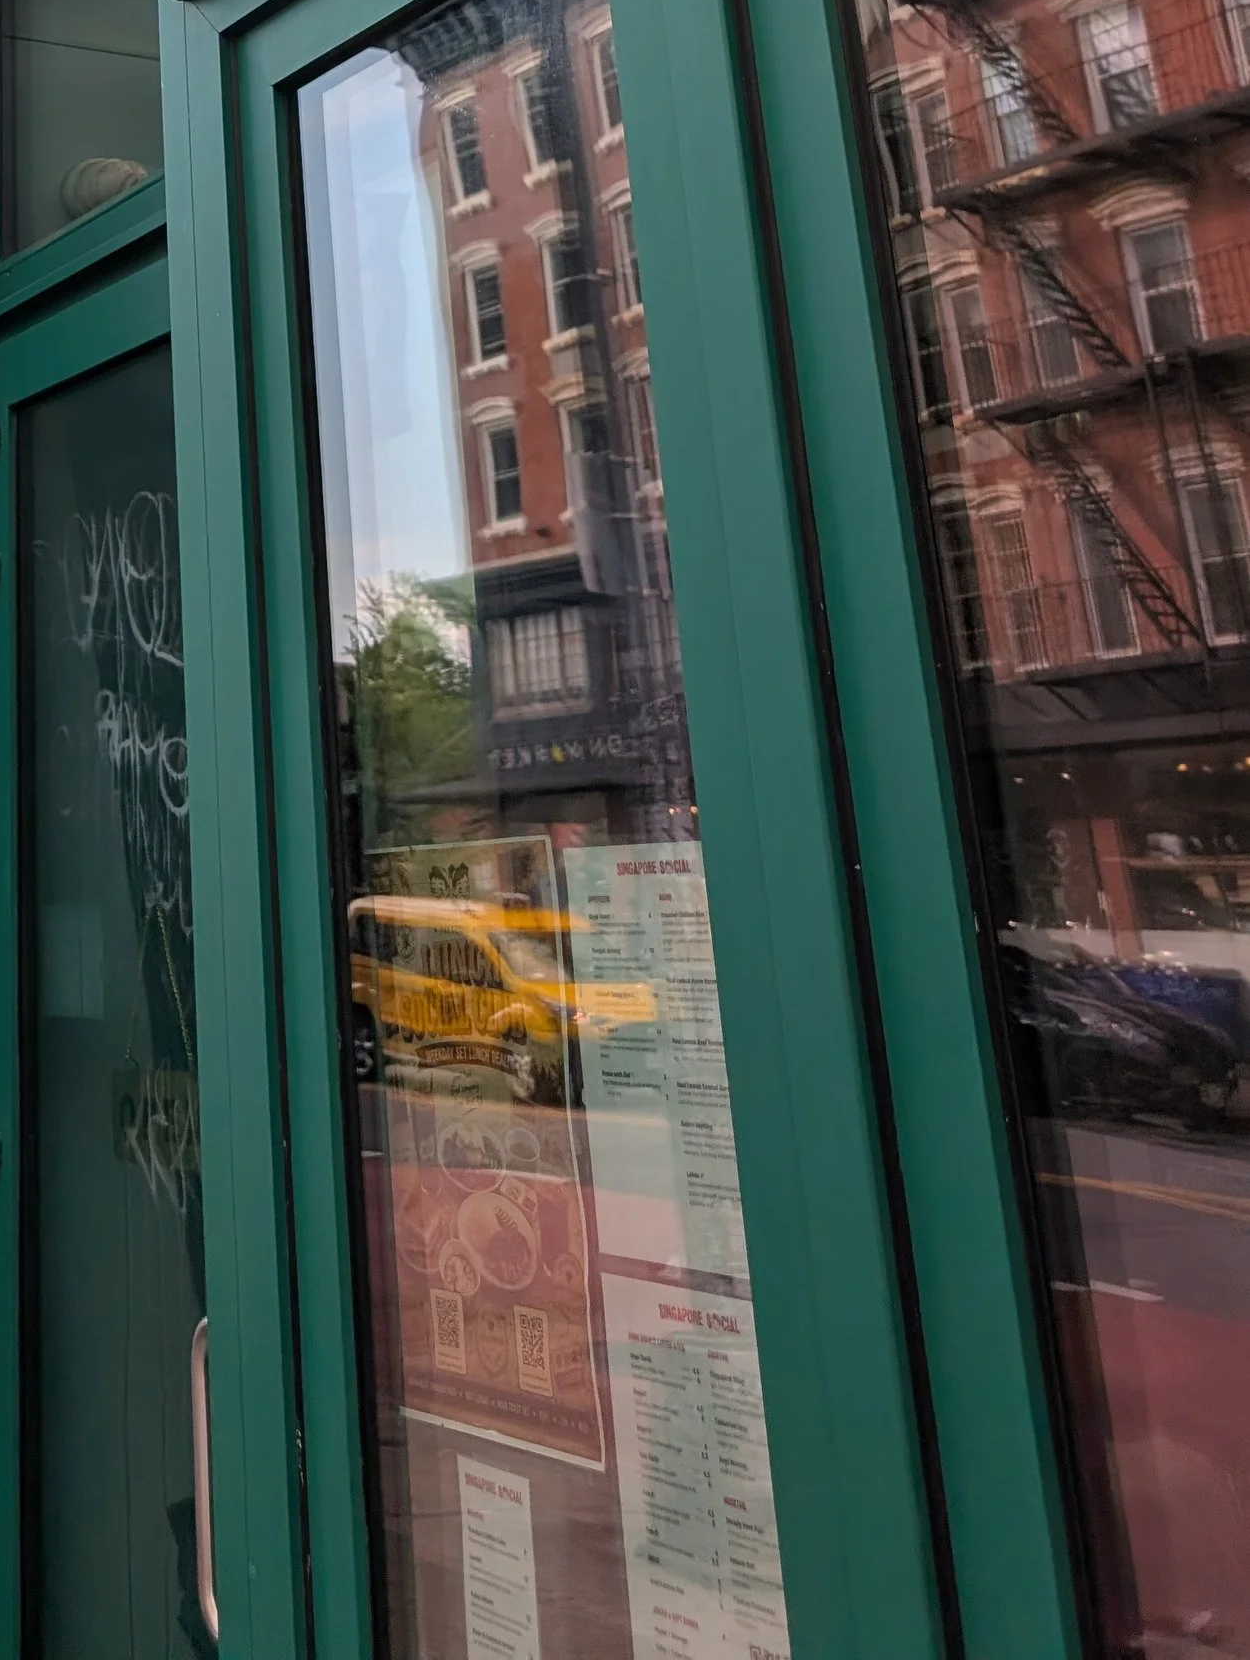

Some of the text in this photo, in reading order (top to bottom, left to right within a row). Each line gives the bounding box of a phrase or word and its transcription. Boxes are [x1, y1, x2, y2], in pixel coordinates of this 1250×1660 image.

[616, 859, 692, 877] SINGAPORE SOCIAL
[455, 1045, 468, 1060] SET
[468, 1046, 490, 1062] LUNCH
[658, 1303, 741, 1335] SINGAPORE SOCIAL
